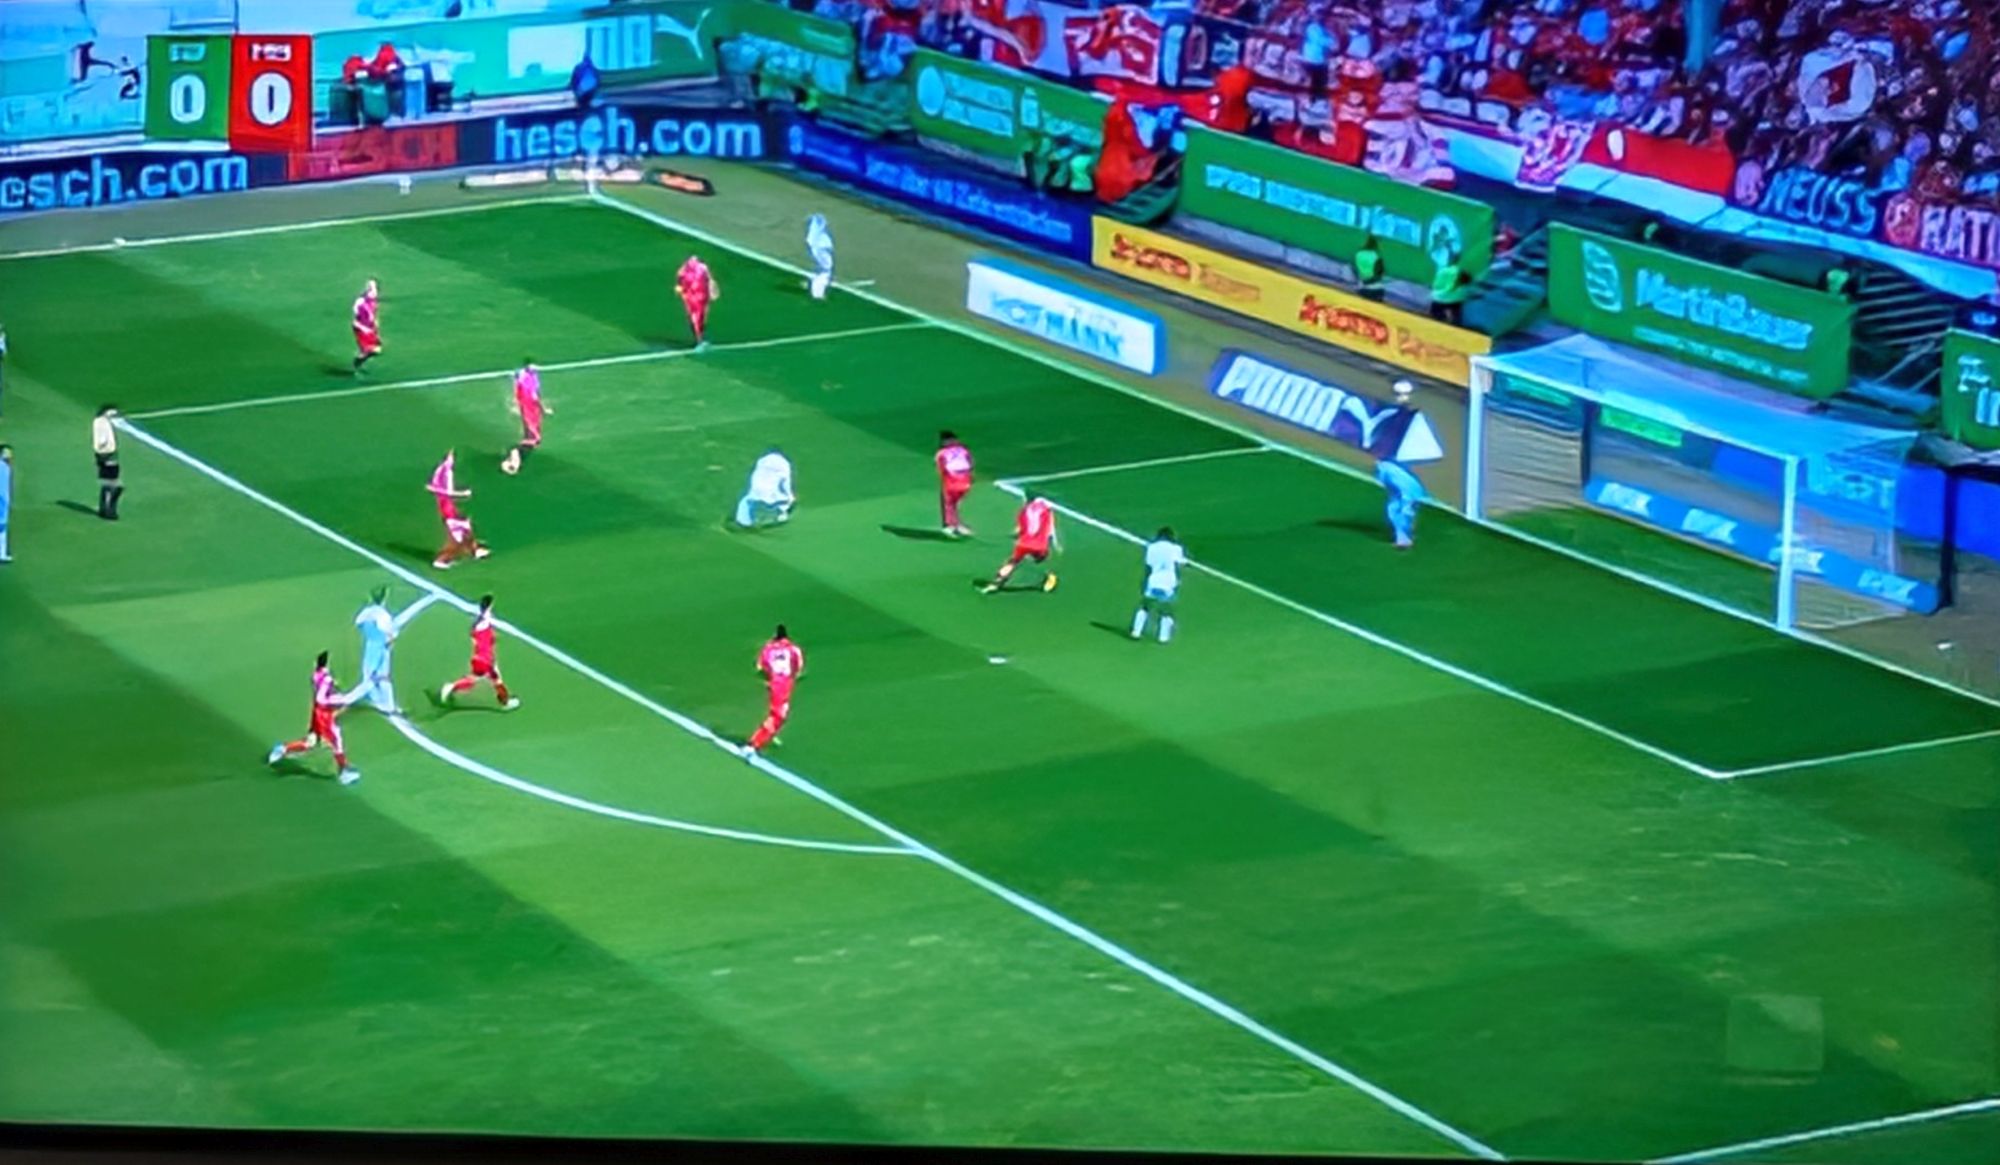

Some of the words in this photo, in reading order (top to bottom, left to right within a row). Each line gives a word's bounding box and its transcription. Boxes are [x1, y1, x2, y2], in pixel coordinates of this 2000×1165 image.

[170, 74, 206, 124] 0
[251, 72, 292, 125] 0
[495, 106, 764, 162] hesch.com
[0, 155, 248, 209] esch.com
[1758, 167, 1877, 233] NEUSS
[1216, 355, 1346, 433] PUMA
